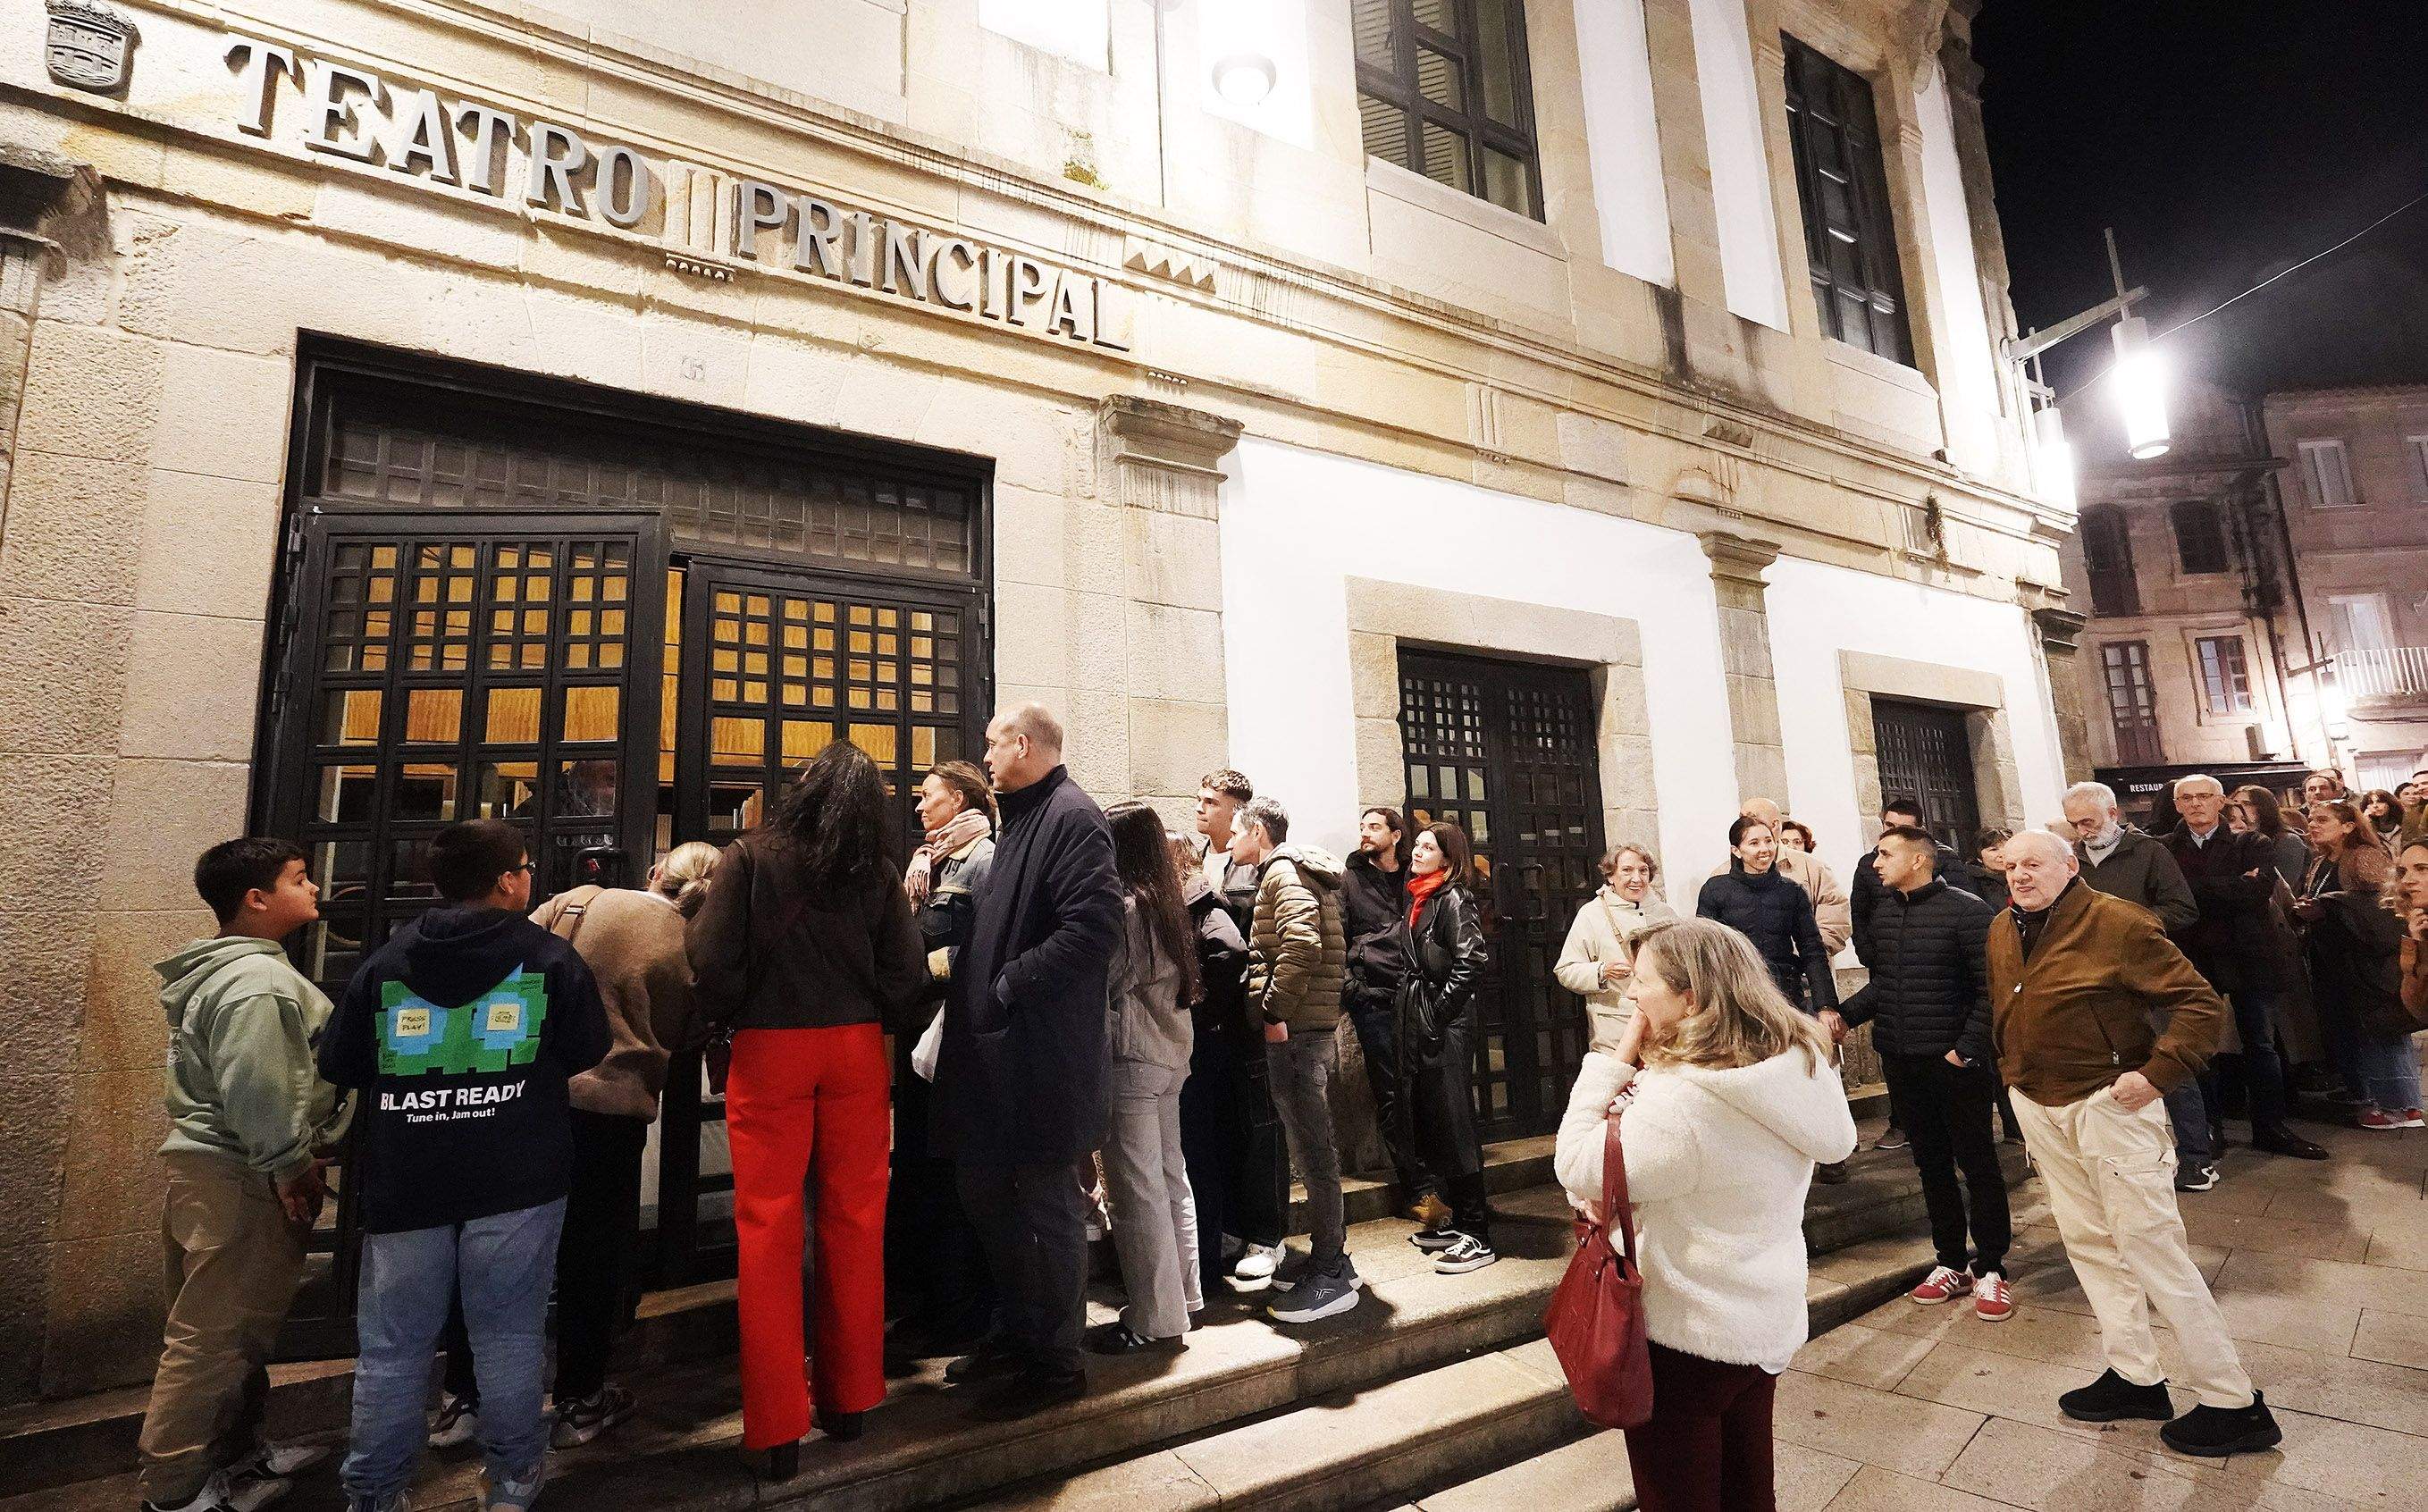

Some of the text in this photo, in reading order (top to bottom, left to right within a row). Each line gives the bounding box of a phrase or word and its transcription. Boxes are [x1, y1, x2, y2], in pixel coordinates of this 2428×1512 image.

[224, 36, 1130, 351] TEATRO PRINCIPAL
[381, 1079, 525, 1111] BLAST READY
[407, 1107, 495, 1123] Tune in, Jam out!
